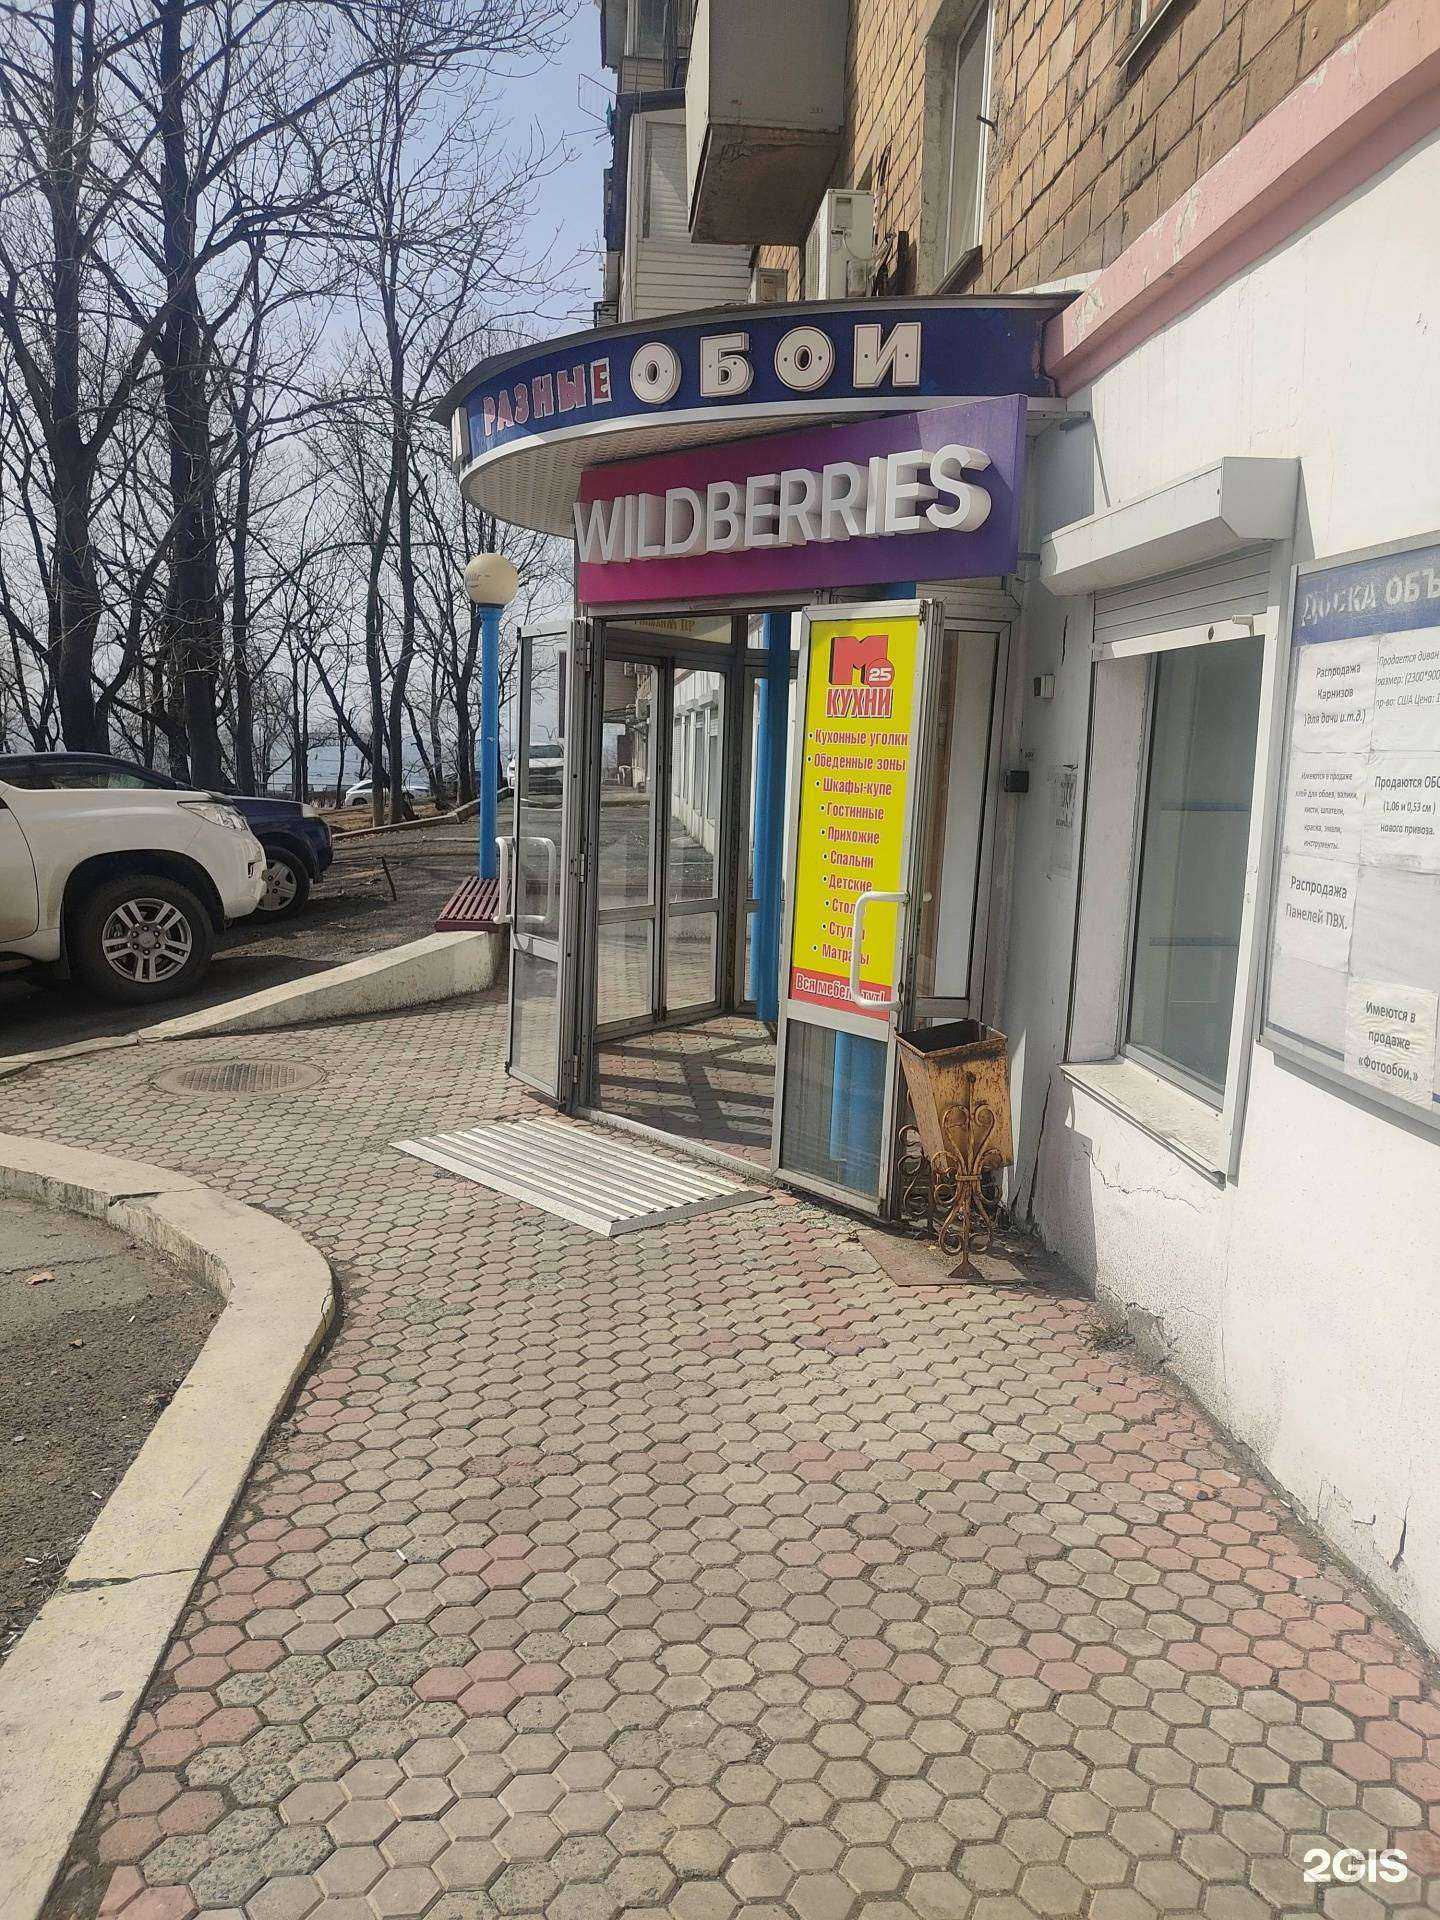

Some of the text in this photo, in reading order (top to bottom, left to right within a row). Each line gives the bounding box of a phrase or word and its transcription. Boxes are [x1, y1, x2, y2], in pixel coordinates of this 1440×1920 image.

[483, 322, 922, 437] РАЗНЫЕ ОБОИ
[573, 444, 992, 565] WILDBERRIES
[868, 667, 892, 682] 25
[1316, 663, 1360, 678] Распродажа
[827, 688, 893, 718] КУХНИ
[1318, 688, 1354, 702] Карнизов
[1397, 695, 1413, 706] США
[815, 730, 908, 747] Кухонные уголки
[814, 753, 906, 771] Обеденные зоны
[823, 778, 892, 796] Шкафы-купе
[1375, 776, 1421, 790] Продаются
[826, 802, 884, 820] Гостинные
[828, 826, 880, 844] Прихожие
[1380, 824, 1435, 836] нового привоза.
[830, 850, 874, 868] Спальни
[828, 874, 872, 892] Детские
[1290, 875, 1347, 899] Распродажа
[832, 898, 864, 915] Стол
[1286, 903, 1348, 930] Панелей ПВХ.
[822, 944, 869, 965] Матраы
[796, 973, 816, 992] Вся
[817, 979, 857, 1000] мебел
[1365, 1001, 1416, 1023] Имеются в
[1368, 1030, 1411, 1050] продаже
